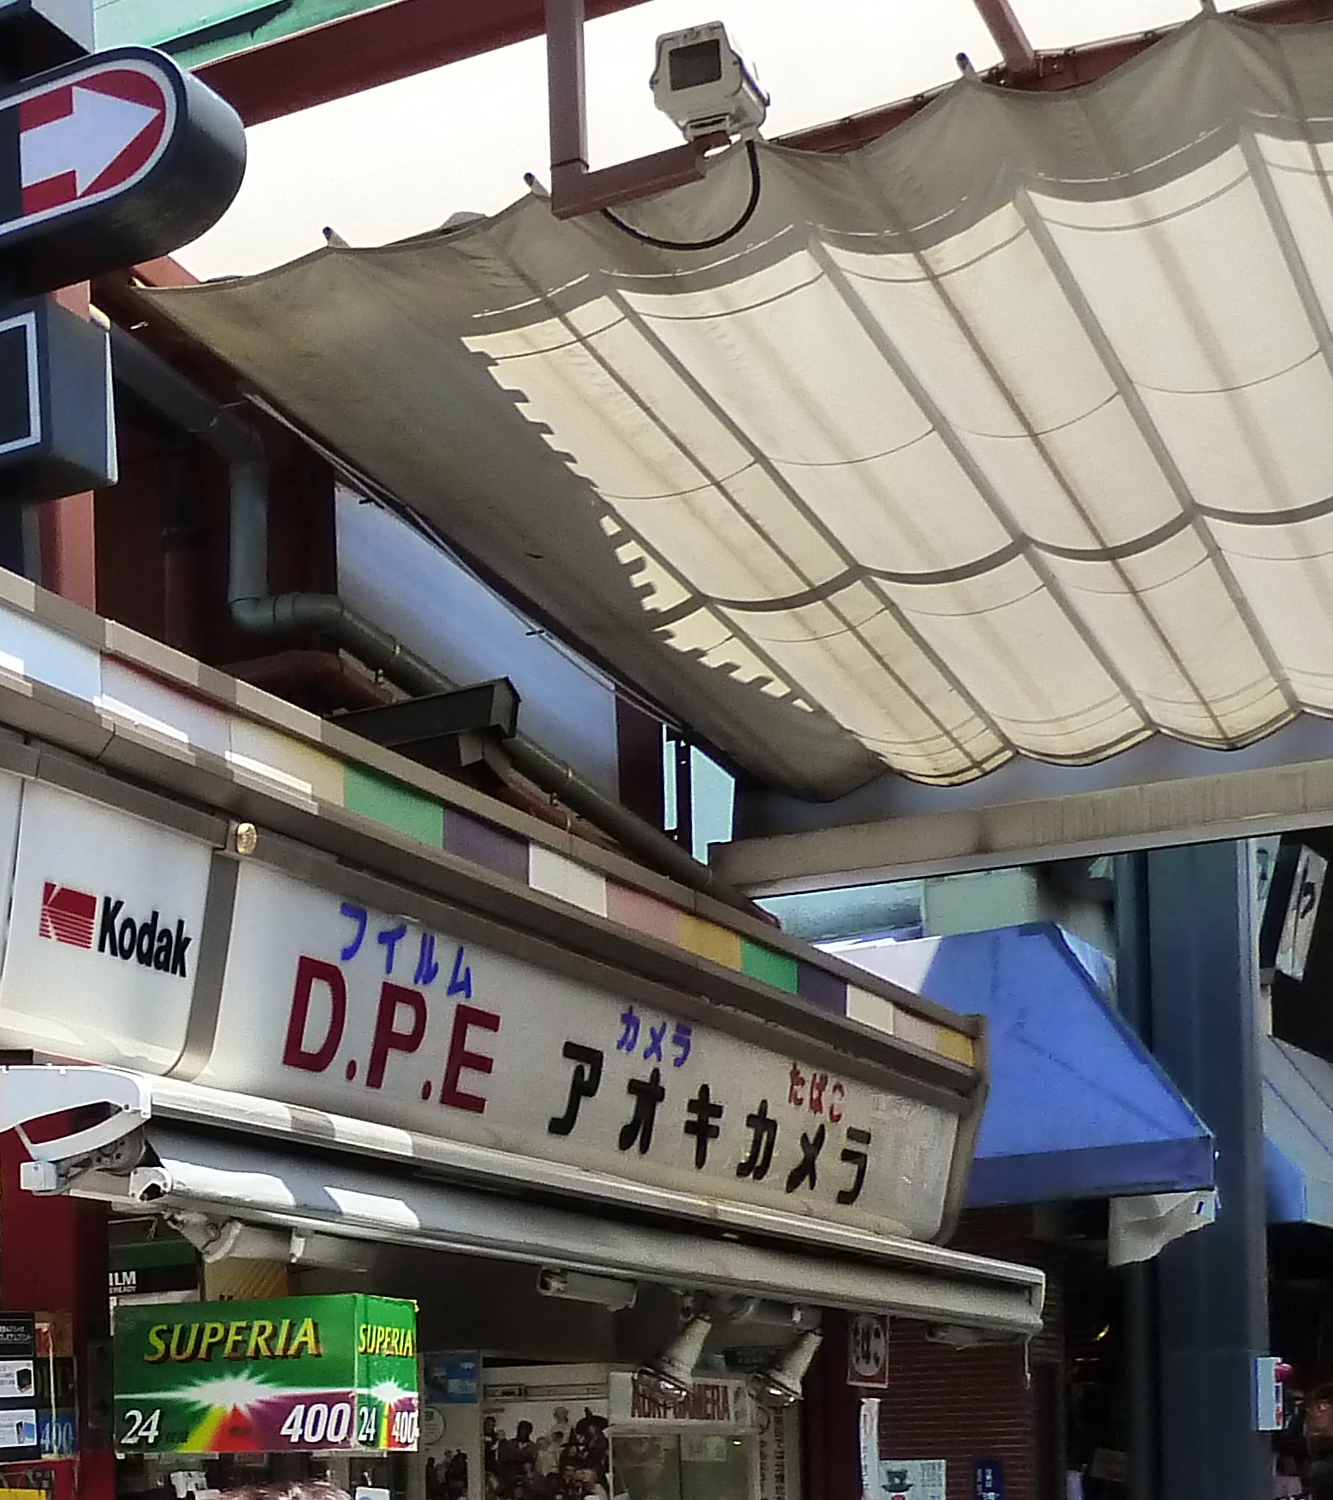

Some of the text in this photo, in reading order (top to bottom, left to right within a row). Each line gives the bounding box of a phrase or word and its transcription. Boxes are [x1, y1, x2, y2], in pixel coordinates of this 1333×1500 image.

[96, 895, 192, 978] Kodak
[282, 955, 501, 1114] D.P.E
[615, 1004, 694, 1069] カメラ
[787, 1061, 846, 1123] たばこ
[546, 1040, 873, 1206] アオキカメラ
[144, 1317, 322, 1363] SUPERIA
[358, 1324, 415, 1358] SUPERIA
[120, 1408, 162, 1446] 24
[280, 1402, 354, 1445] 400
[358, 1406, 376, 1443] 24
[391, 1410, 417, 1444] 400
